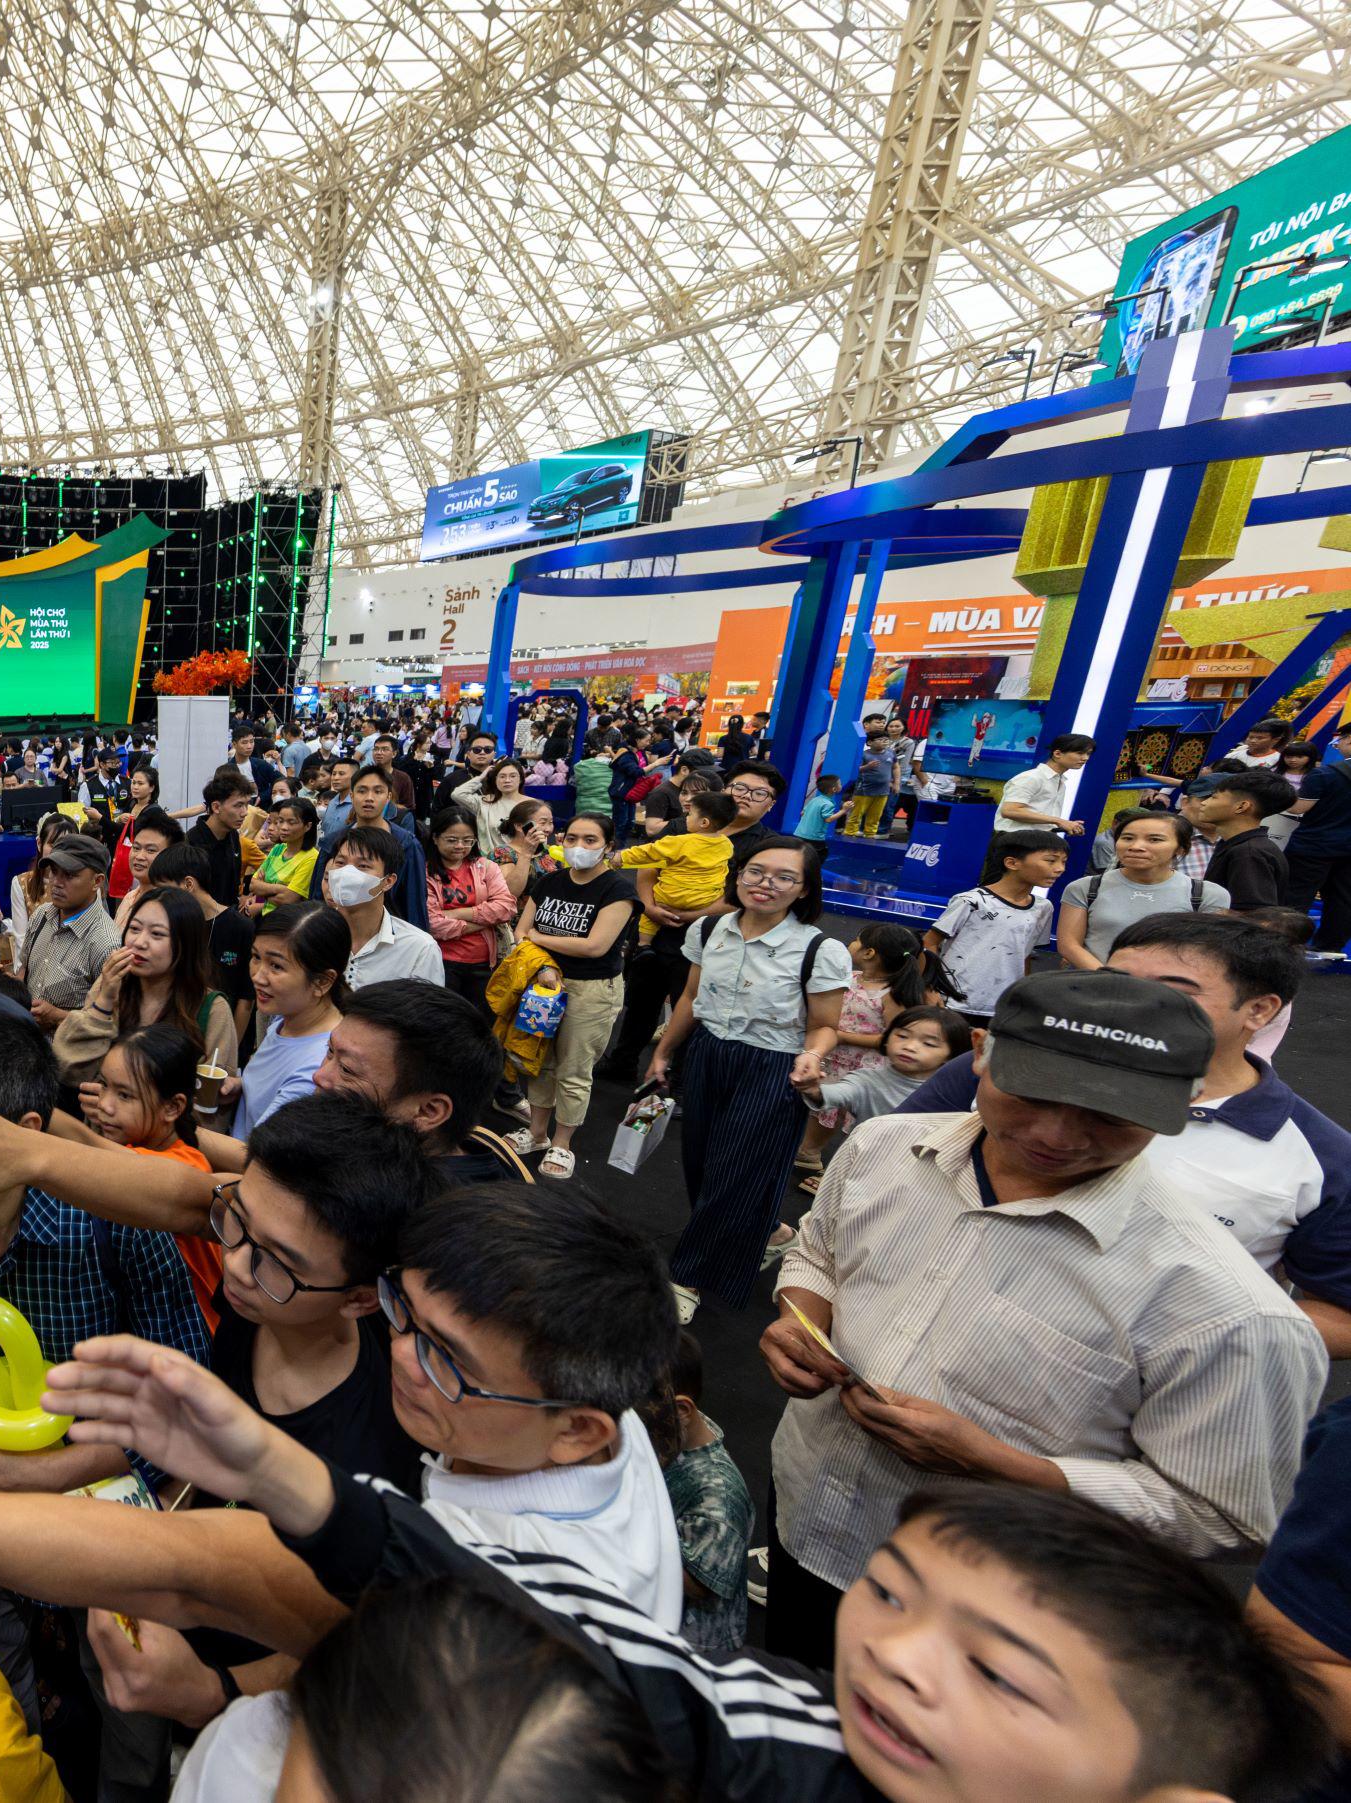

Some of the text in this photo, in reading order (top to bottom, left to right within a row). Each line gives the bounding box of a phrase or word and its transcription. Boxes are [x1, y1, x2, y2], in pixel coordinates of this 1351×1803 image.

[1284, 201, 1327, 235] NỘI
[483, 478, 500, 508] 5
[499, 489, 518, 503] SAO
[445, 586, 480, 603] Sảnh
[30, 607, 66, 618] HỘI CHỢ
[443, 602, 465, 615] Hall
[30, 618, 68, 627] MÙA THU
[30, 628, 47, 638] LẦN
[49, 629, 66, 638] THỨ
[440, 618, 457, 644] 2
[840, 613, 896, 638] ÁH
[928, 606, 1001, 633] MÙA
[30, 641, 49, 649] 2025
[904, 842, 942, 867] VTC
[539, 896, 595, 919] MYSELF
[535, 908, 589, 933] OWNRULE
[1043, 1015, 1169, 1052] BALENCIAGA
